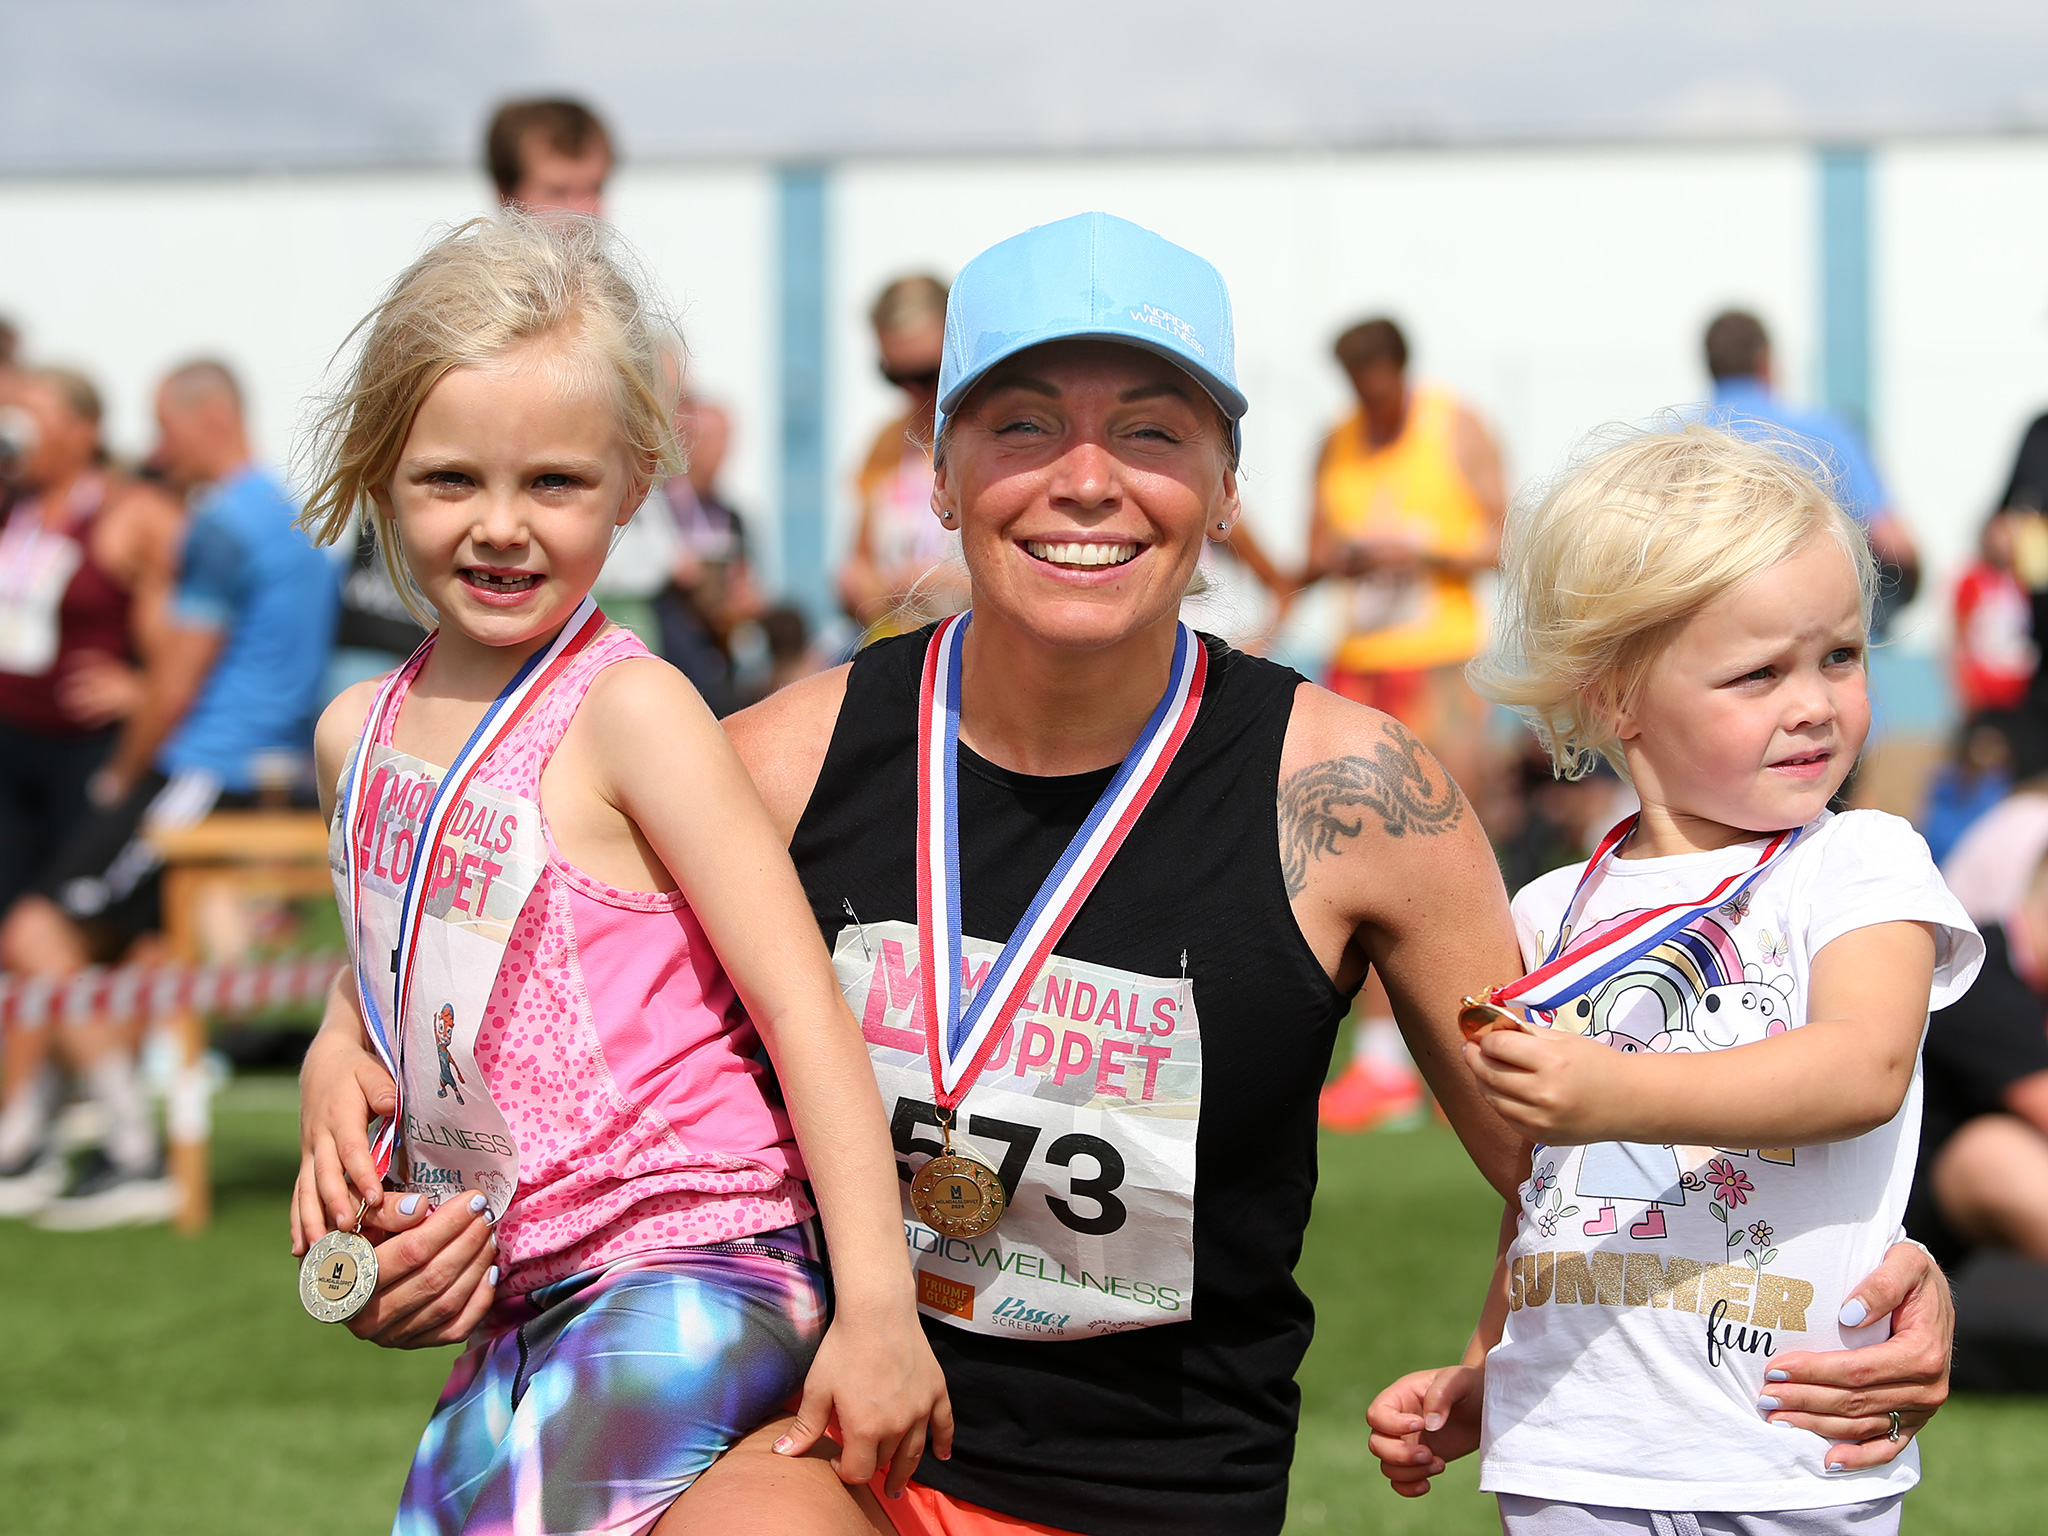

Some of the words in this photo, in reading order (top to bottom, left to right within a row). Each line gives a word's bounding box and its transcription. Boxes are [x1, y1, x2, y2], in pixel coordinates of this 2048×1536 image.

[1129, 309, 1206, 358] WELLNESS
[1143, 303, 1196, 338] NORDIC
[386, 772, 518, 855] MÖLDALS
[374, 821, 504, 918] LOPET
[406, 1114, 513, 1157] ELLNESS
[891, 1096, 1128, 1236] 573
[923, 1277, 969, 1300] TRIUMF
[926, 1290, 964, 1312] GLASS
[1510, 1250, 1814, 1332] SUMMER
[992, 1315, 1042, 1333] SCREEN
[1047, 1327, 1065, 1336] AB
[1706, 1298, 1777, 1368] fun
